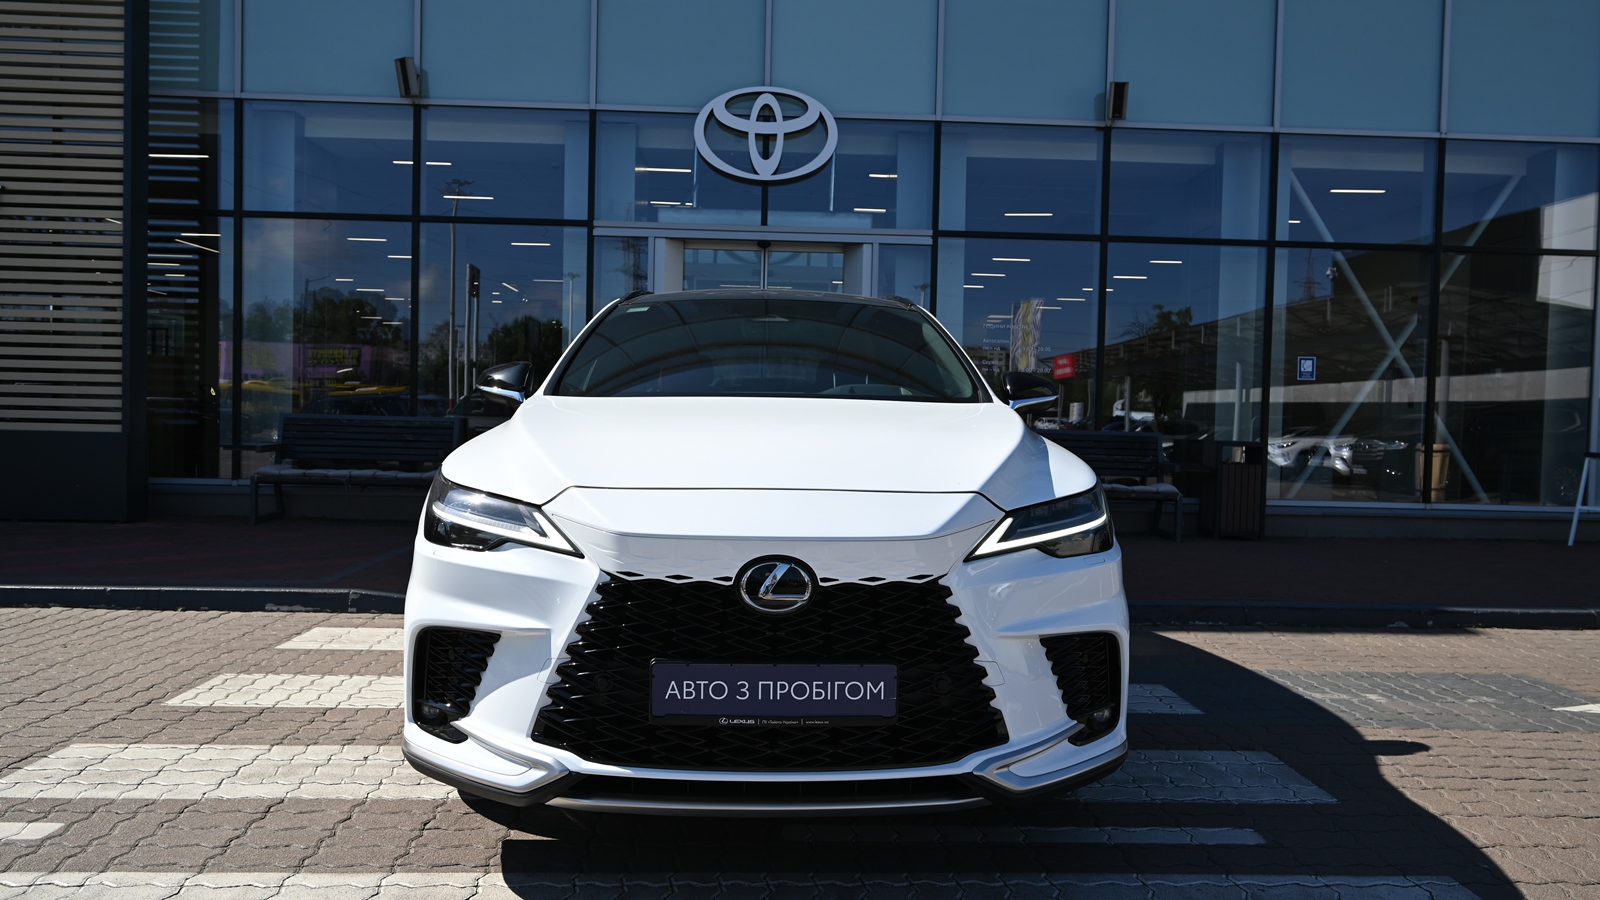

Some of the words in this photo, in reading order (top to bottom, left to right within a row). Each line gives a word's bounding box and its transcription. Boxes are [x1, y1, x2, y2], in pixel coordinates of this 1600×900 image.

[665, 680, 728, 700] АВТО
[736, 680, 750, 700] З
[758, 680, 885, 700] ПРОБІГОМ
